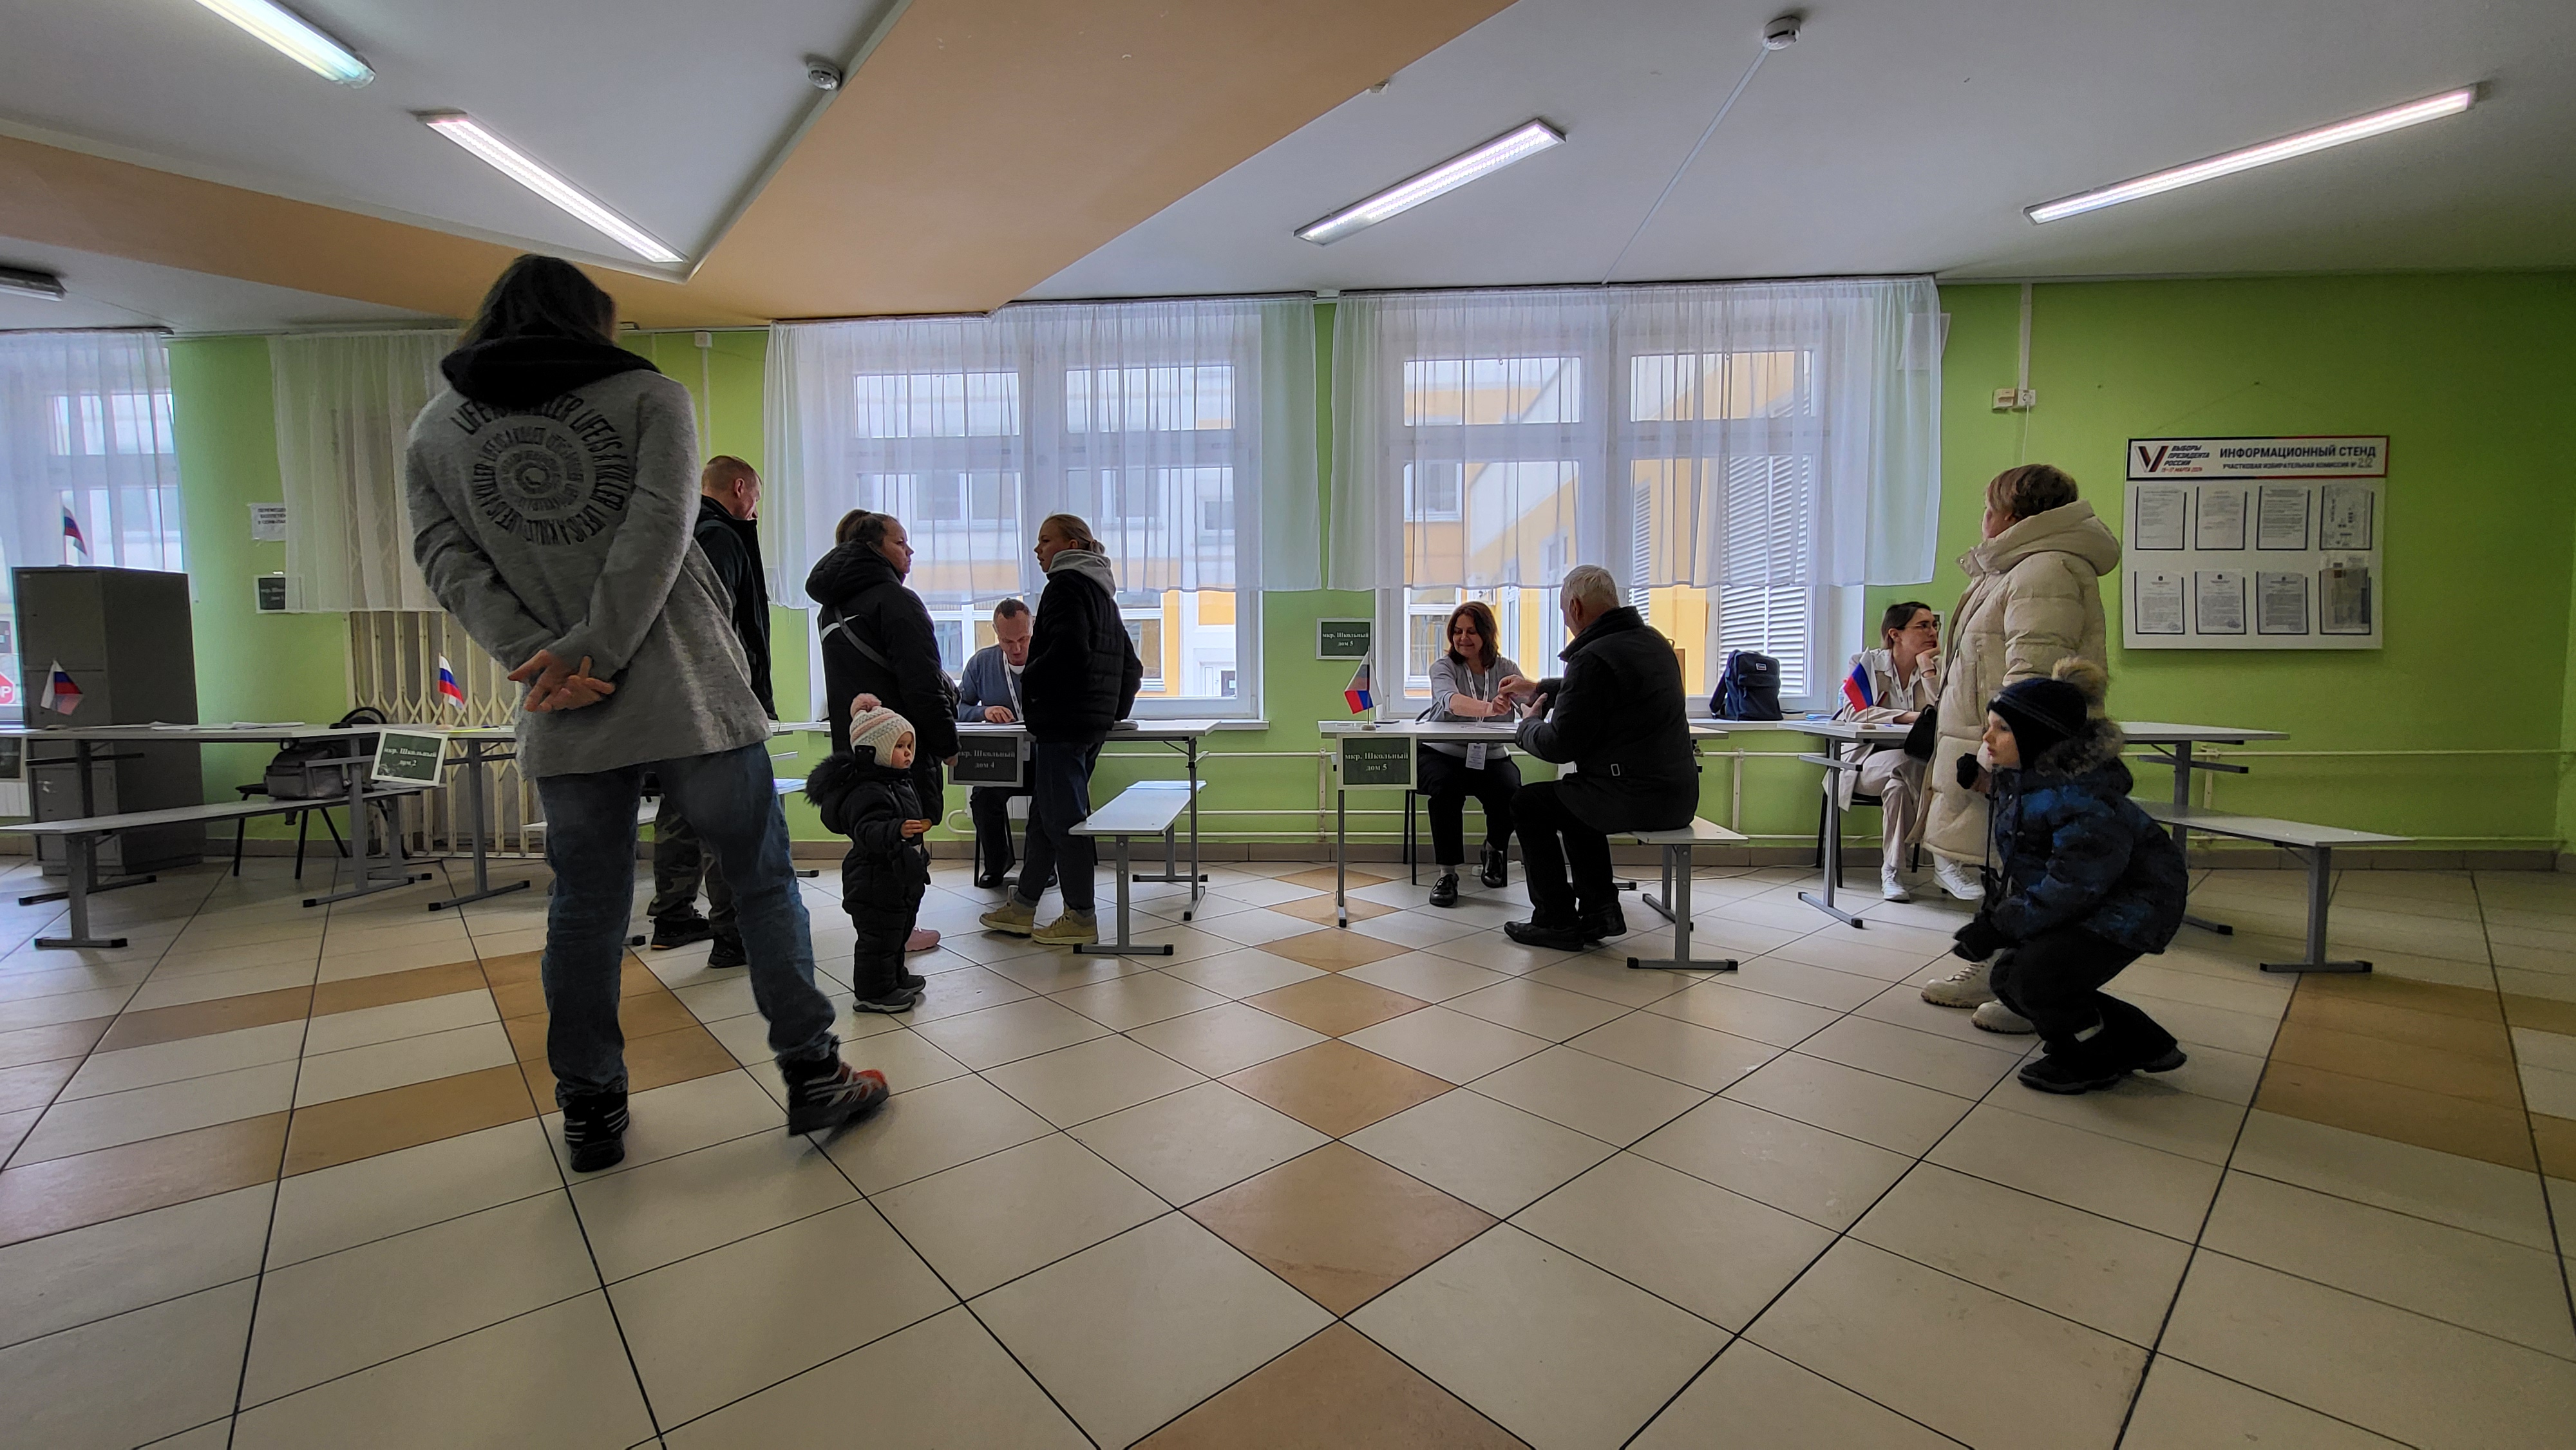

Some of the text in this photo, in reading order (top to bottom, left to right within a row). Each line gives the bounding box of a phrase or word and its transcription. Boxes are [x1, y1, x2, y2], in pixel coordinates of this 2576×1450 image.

[570, 409, 615, 440] LIFE
[2220, 445, 2376, 458] ИНФОРМАЦИОННЫЙ СТЕНД
[473, 464, 497, 499] KILLER
[590, 464, 630, 511] KILLER
[576, 505, 607, 535] LIFE
[400, 748, 437, 757] Школьный
